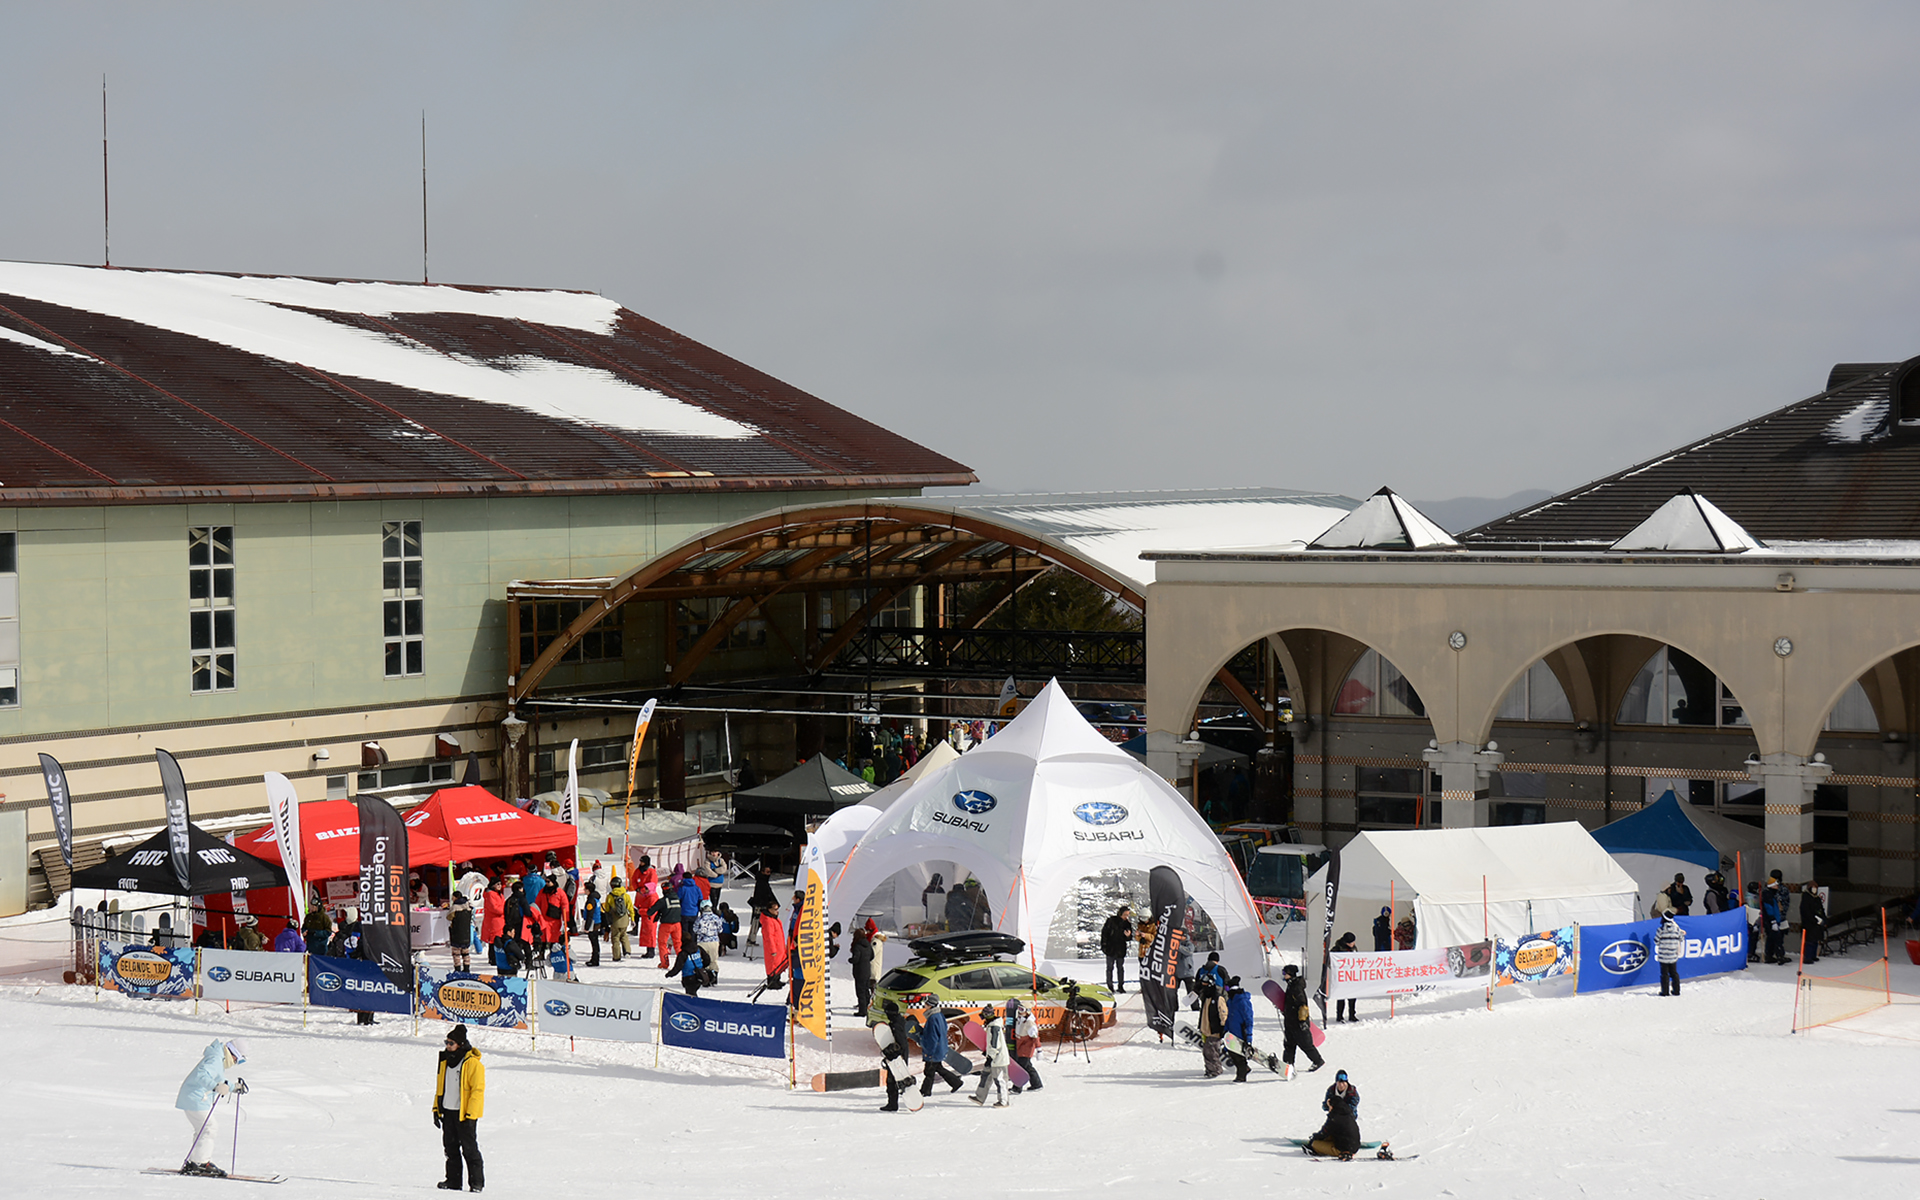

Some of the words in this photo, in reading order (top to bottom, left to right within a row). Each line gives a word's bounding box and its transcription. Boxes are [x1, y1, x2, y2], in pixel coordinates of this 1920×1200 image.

[830, 782, 875, 796] THULE
[455, 811, 522, 825] BLIZZAK
[932, 811, 990, 833] SUBARU
[1073, 829, 1145, 842] SUBARU
[128, 850, 168, 866] FNTC
[196, 848, 237, 865] FNTC
[118, 877, 139, 890] FNTC
[1337, 956, 1396, 969] ブリザックは、
[235, 970, 295, 983] SUBARU
[442, 988, 475, 1004] GELANDE
[478, 993, 496, 1007] TAXI
[575, 1005, 642, 1021] SUBARU
[704, 1020, 776, 1038] SUBARU
